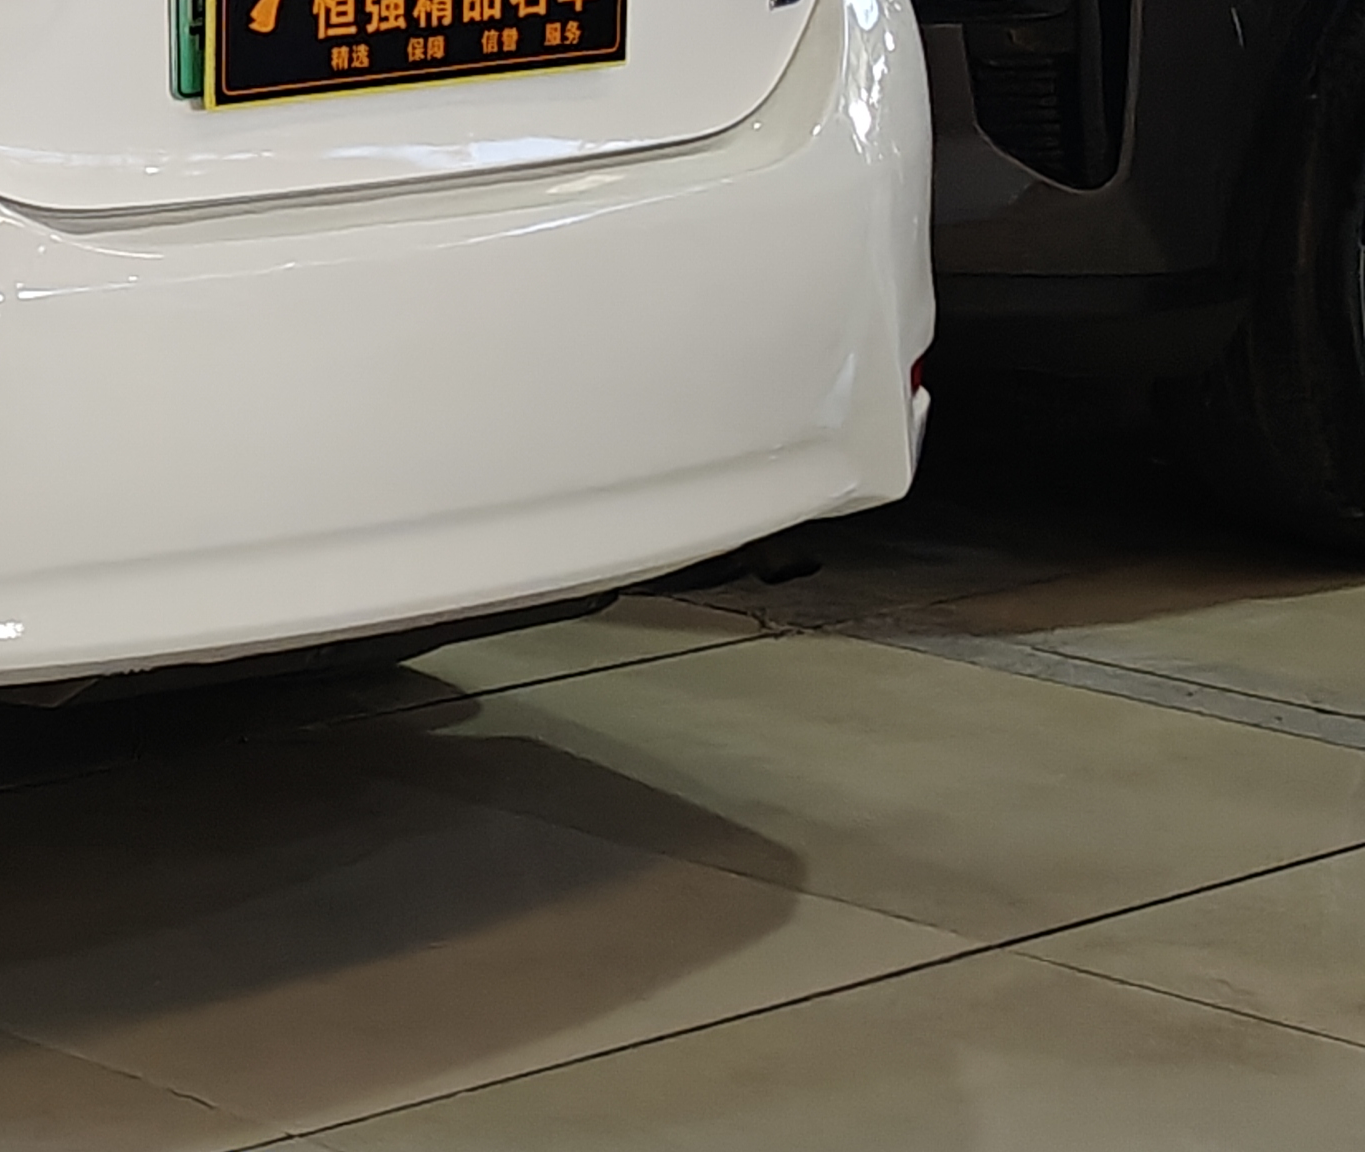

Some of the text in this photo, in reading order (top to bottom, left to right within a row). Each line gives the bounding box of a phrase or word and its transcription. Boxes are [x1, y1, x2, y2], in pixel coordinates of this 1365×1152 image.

[331, 21, 582, 71] 精选 保障 信誉 服务
